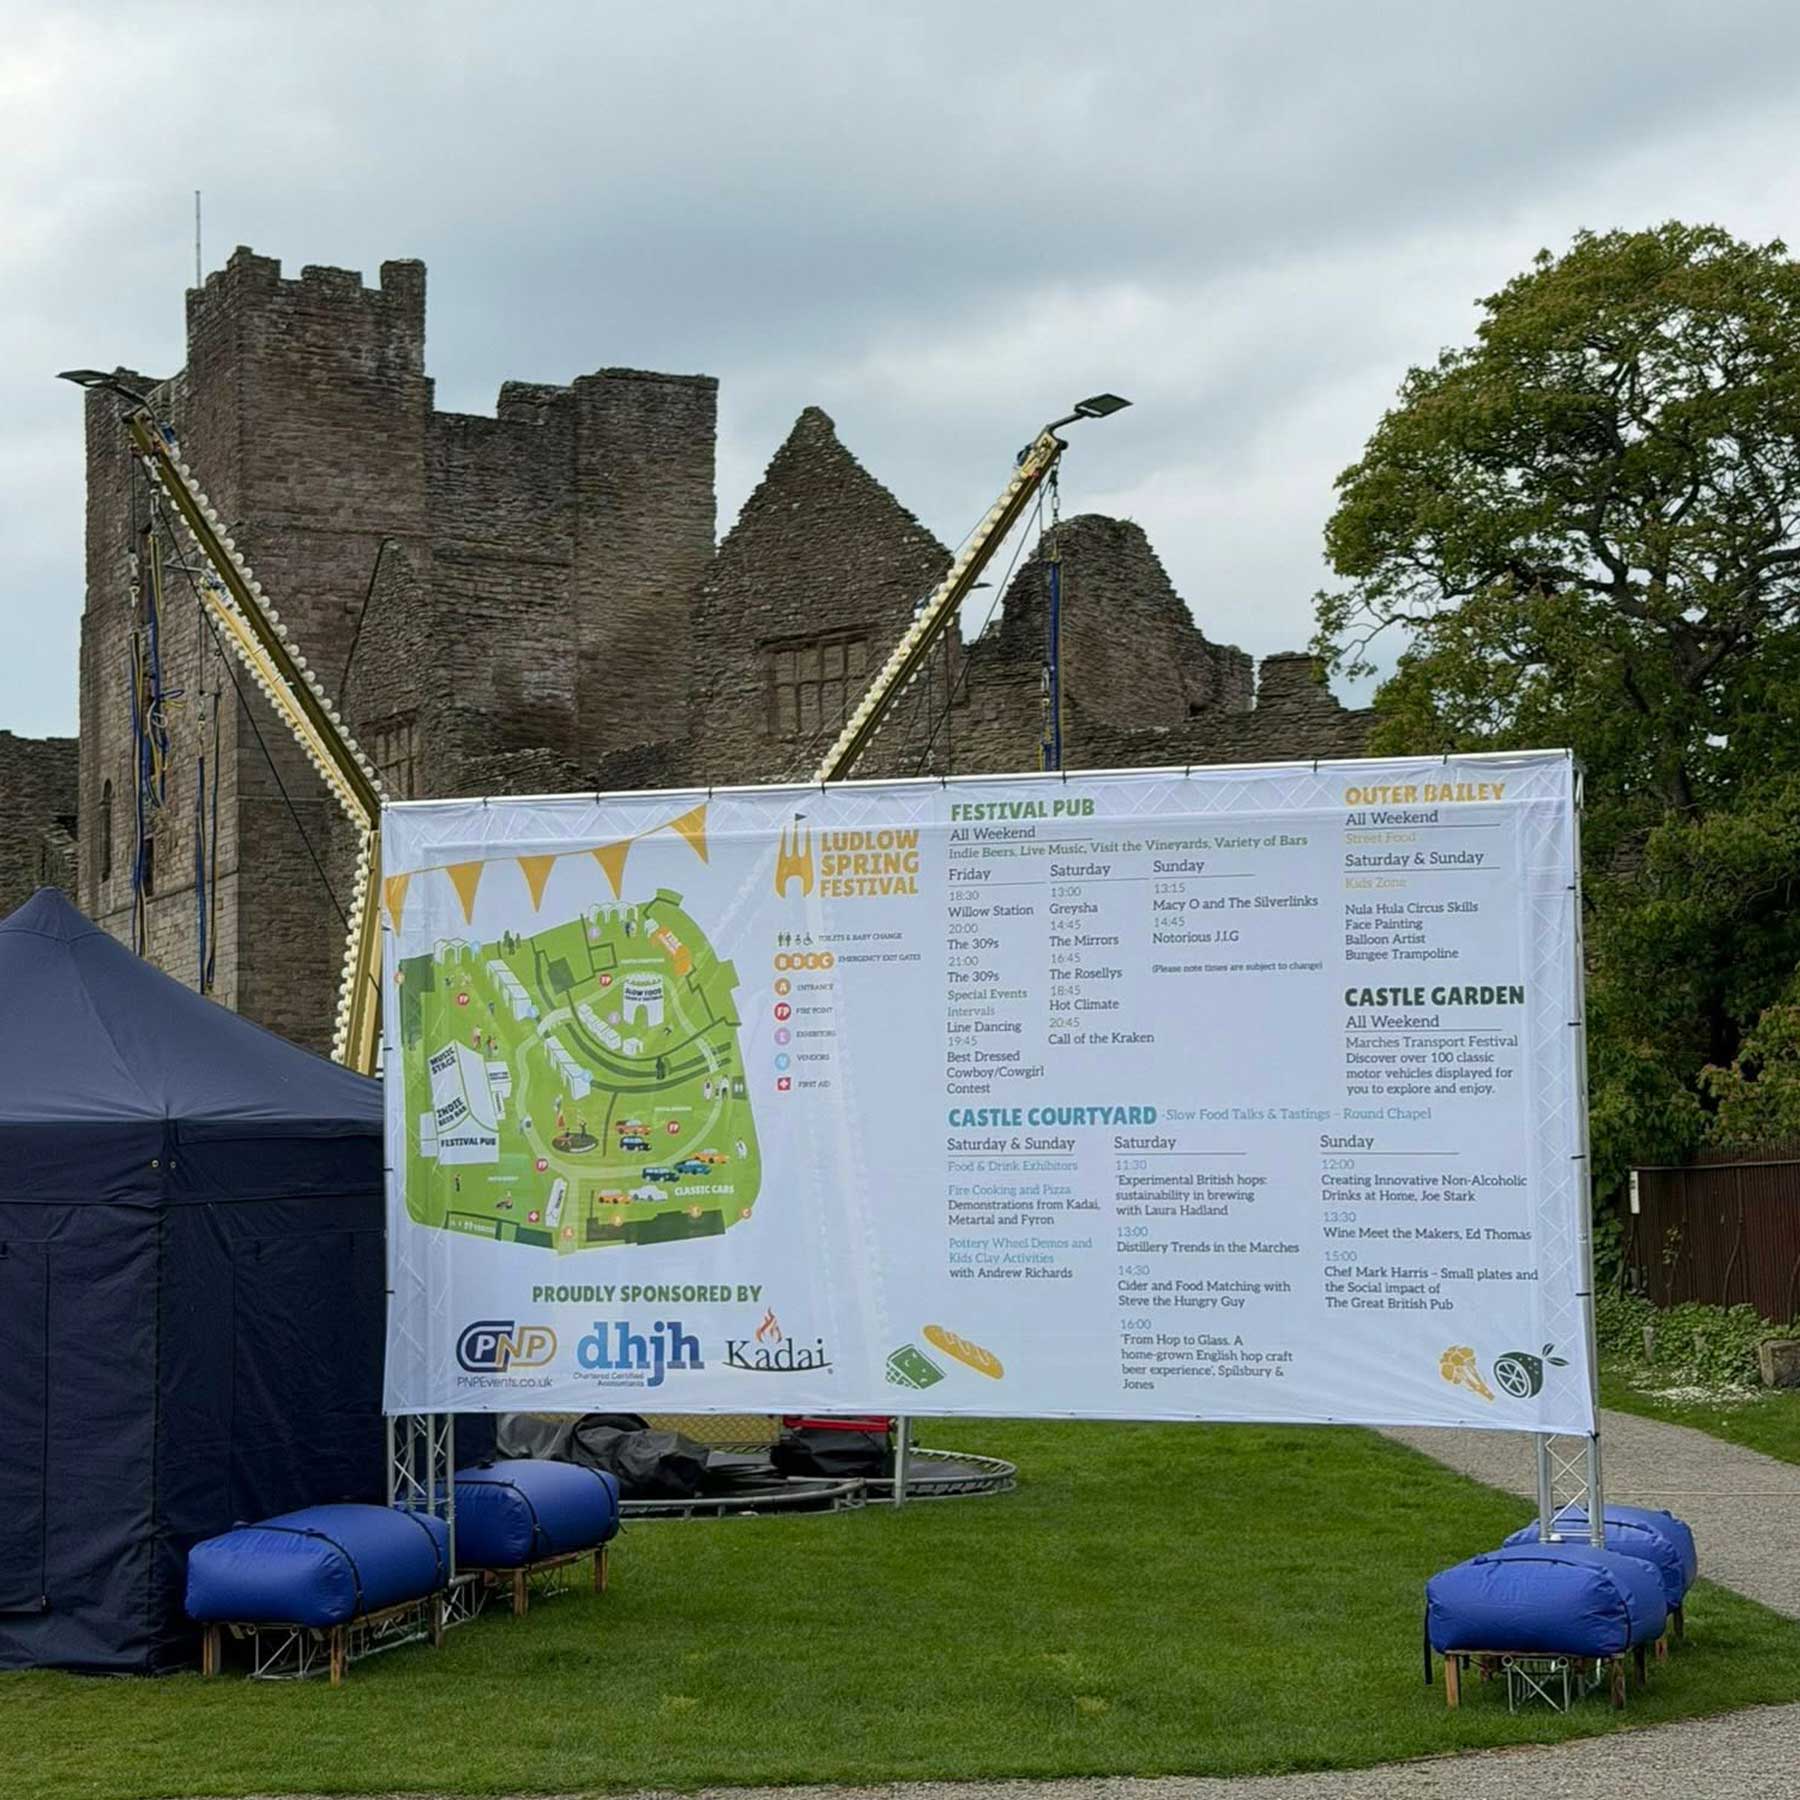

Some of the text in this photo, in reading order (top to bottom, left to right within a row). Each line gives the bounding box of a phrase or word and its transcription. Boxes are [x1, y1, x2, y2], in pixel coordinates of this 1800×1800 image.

[1345, 783, 1505, 805] OUTER BAILEY
[952, 798, 1095, 821] FESTIVAL PUB
[1345, 810, 1439, 826] All Weekend
[821, 829, 919, 851] LUDLOW
[950, 826, 1035, 841] All Weekend
[949, 848, 979, 860] Indie
[1020, 845, 1046, 856] Live
[1091, 842, 1118, 853] Visit
[1123, 841, 1142, 852] the
[1214, 836, 1261, 849] Variety
[1263, 835, 1277, 847] of
[1280, 835, 1308, 846] Bars
[821, 851, 919, 876] SPRING
[1345, 851, 1484, 867] Saturday & Sunday
[1050, 863, 1111, 877] Saturday
[1153, 860, 1204, 873] Sunday
[949, 869, 991, 882] Friday
[820, 876, 918, 897] FESTIVAL
[1051, 887, 1082, 897] 13:00
[950, 890, 979, 901] 18:30
[1049, 903, 1098, 915] Greysha
[1153, 896, 1318, 911] Macy O and The Silverlinks
[1345, 901, 1478, 915] Nula Hula Circus Skills
[948, 905, 1034, 917] Willow Station
[949, 923, 978, 933] 20:00
[1051, 920, 1081, 930] 14:45
[1345, 918, 1423, 931] Face Painting
[948, 938, 999, 950] The 309s
[1050, 934, 1119, 946] The Mirrors
[1152, 932, 1212, 944] Notorious
[1345, 933, 1425, 945] Balloon Artist
[949, 956, 979, 966] 21:00
[1051, 953, 1081, 963] 16:45
[1345, 948, 1459, 962] Bungee Trampoline
[1050, 967, 1123, 980] The Rosellys
[1230, 964, 1243, 972] are
[1246, 962, 1276, 973] subject
[1278, 962, 1287, 971] to
[948, 971, 1000, 982] The 309s
[948, 989, 1027, 1001] Special Events
[1344, 985, 1525, 1006] CASTLE GARDEN
[1049, 999, 1120, 1010] Hot Climate
[947, 1021, 1022, 1033] Line Dancing
[1049, 1017, 1080, 1028] 20:45
[1345, 1015, 1440, 1028] All Weekend
[1048, 1032, 1155, 1045] Call of the Kraken
[1345, 1035, 1518, 1049] Marches Transport Festival
[947, 1051, 1020, 1062] Best Dressed
[1346, 1051, 1494, 1064] Discover over 100 classic
[946, 1065, 1044, 1079] Cowboy/Cowgirl
[1346, 1067, 1513, 1080] motor vehicles displayed for
[946, 1083, 990, 1094] Contest
[1346, 1083, 1496, 1096] you to explore and enjoy.
[948, 1105, 1157, 1127] CASTLE COURTYARD
[440, 1137, 496, 1147] FESTIVAL PUB
[947, 1137, 1075, 1152] Saturday & Sunday
[1114, 1136, 1176, 1150] Saturday
[1319, 1135, 1374, 1150] Sunday
[1321, 1174, 1527, 1187] Creating Innovative Non-Alcoholic
[998, 1214, 1018, 1225] and
[1323, 1227, 1532, 1240] Wine Meet the Makers, Ed Thomas
[1116, 1241, 1300, 1254] Distillery Trends in the Marches
[949, 1267, 1073, 1278] with Andrew Richards
[532, 1285, 762, 1303] PROUDLY SPONSORED BY
[1325, 1297, 1453, 1310] The Great British Pub
[470, 1330, 550, 1369] PNP
[576, 1320, 705, 1387] dhjh
[724, 1337, 828, 1370] Kadai
[457, 1376, 552, 1388] PNPEvents.co.uk
